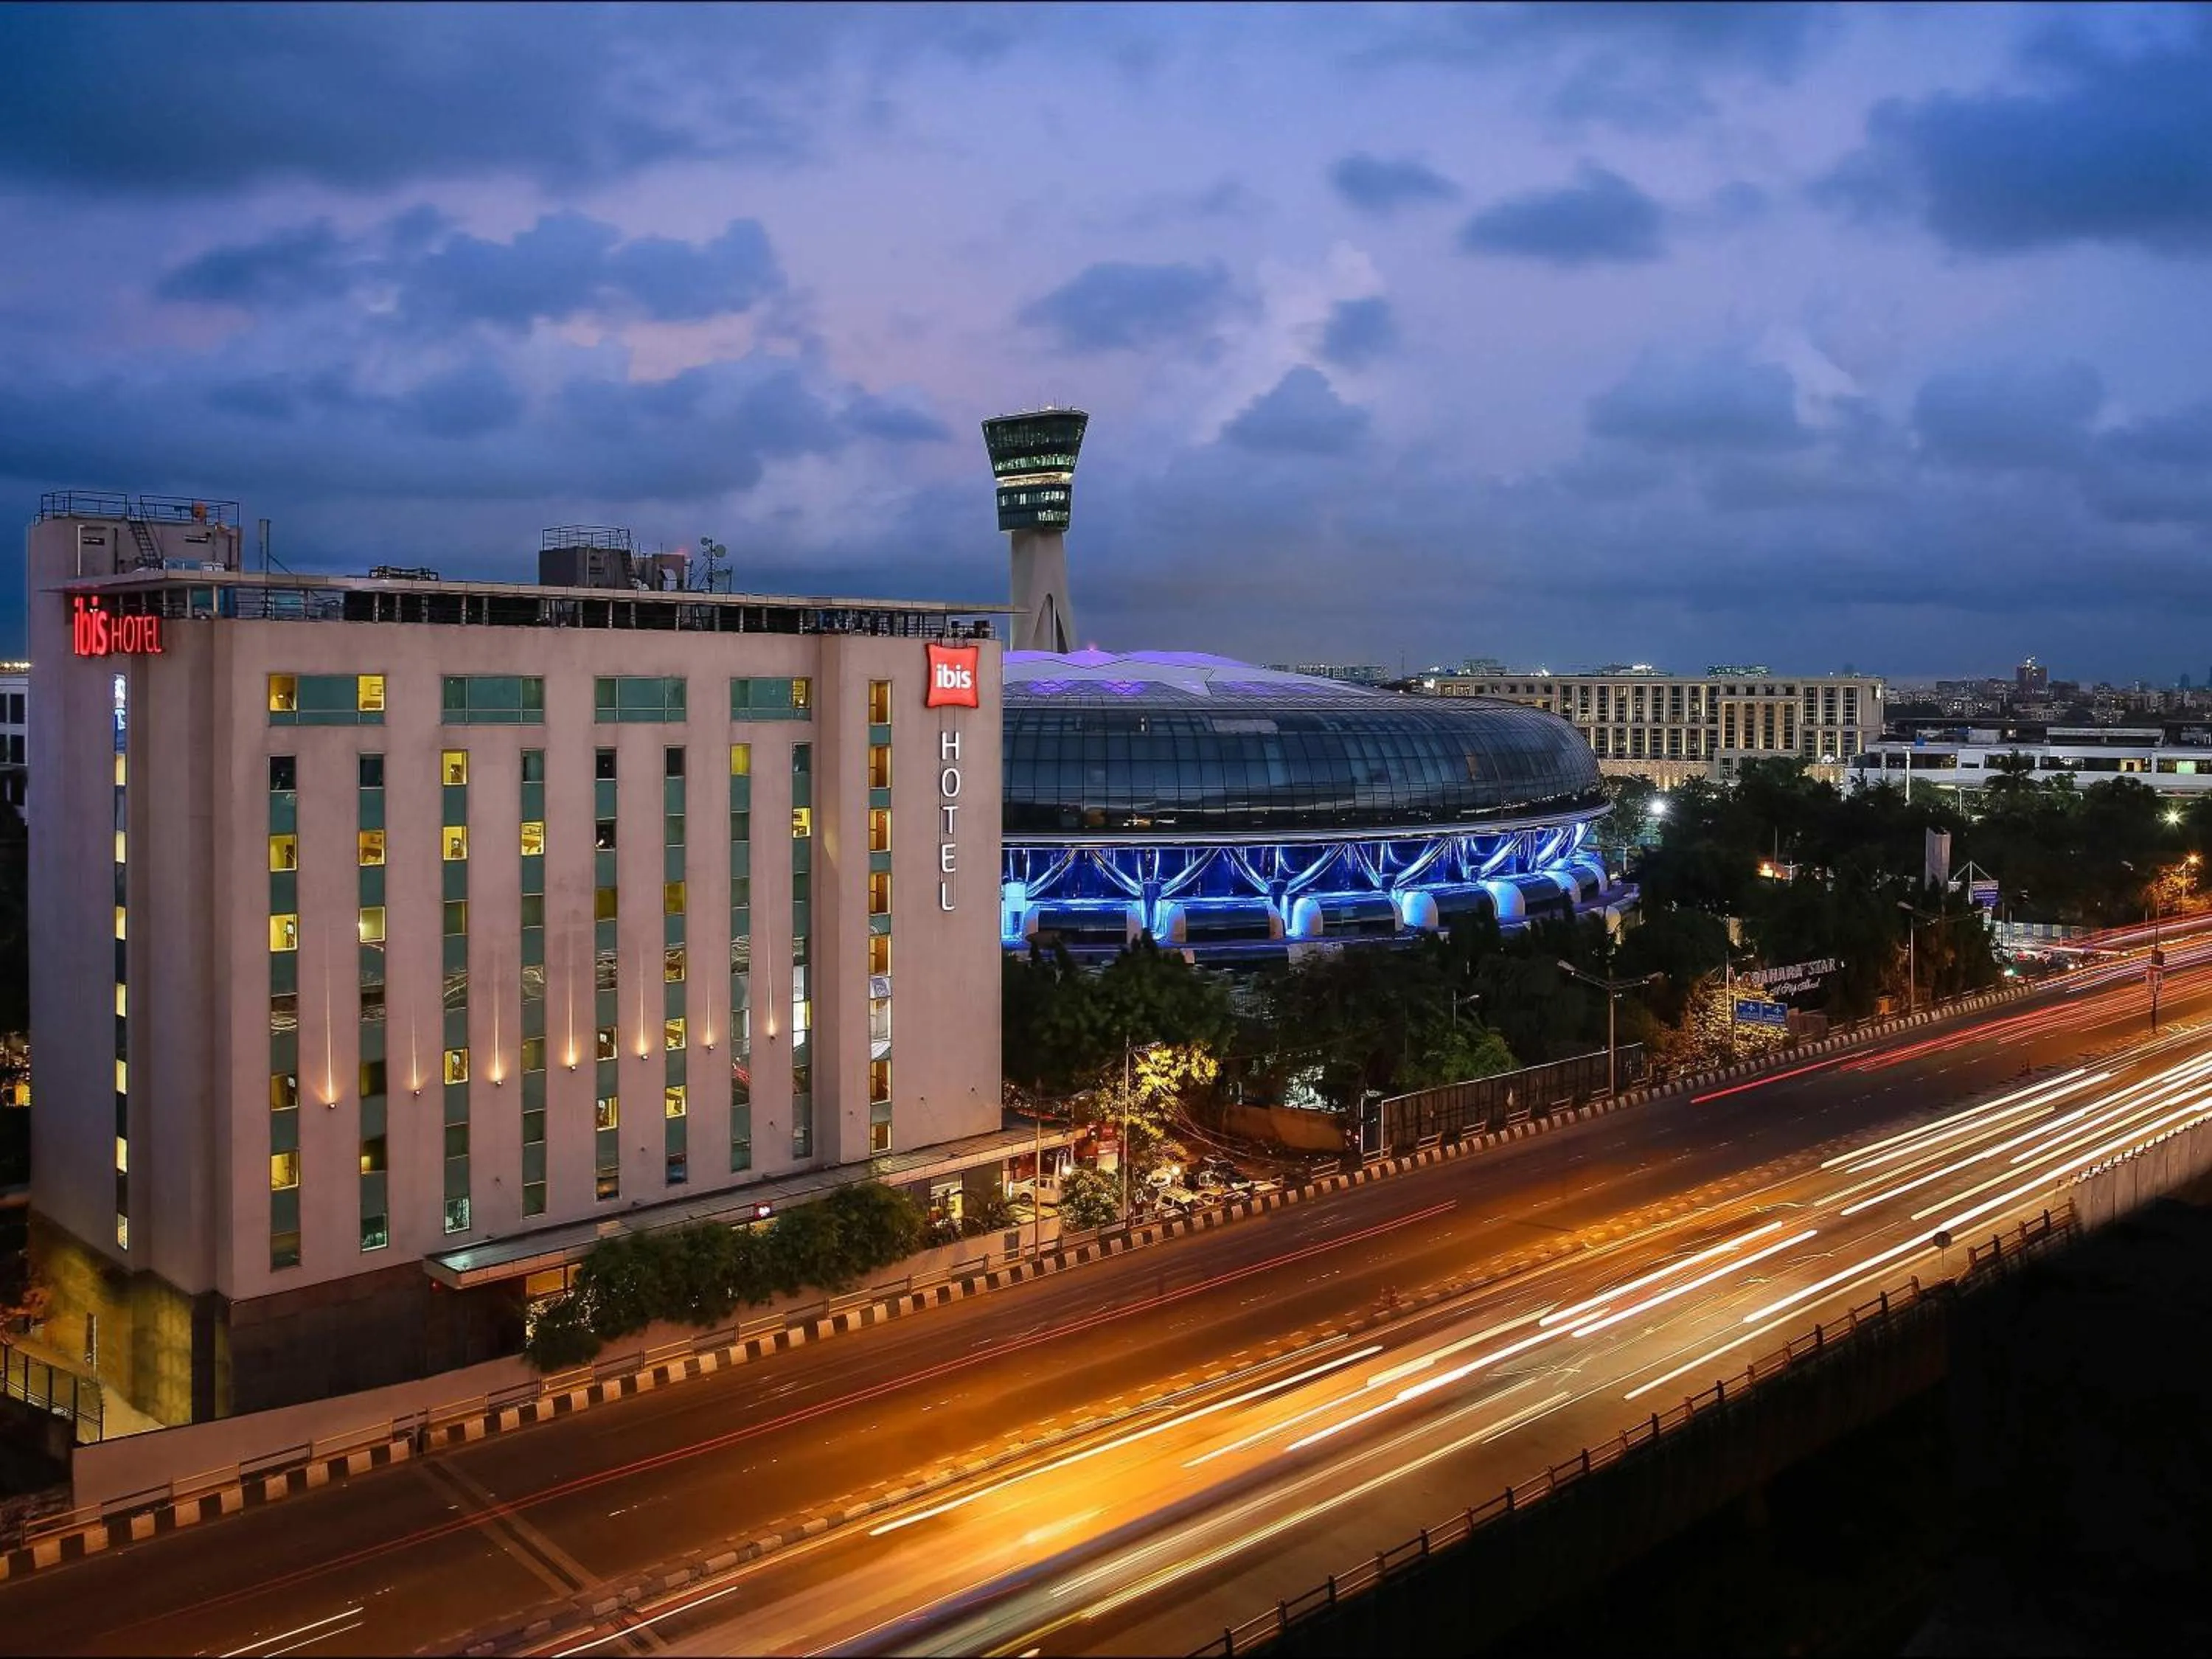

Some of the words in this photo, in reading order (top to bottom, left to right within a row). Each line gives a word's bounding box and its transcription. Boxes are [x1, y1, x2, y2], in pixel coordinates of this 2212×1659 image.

[74, 595, 108, 655] ibis
[111, 615, 163, 654] HOTEL
[936, 663, 973, 689] ibis
[941, 731, 961, 911] HOTEL
